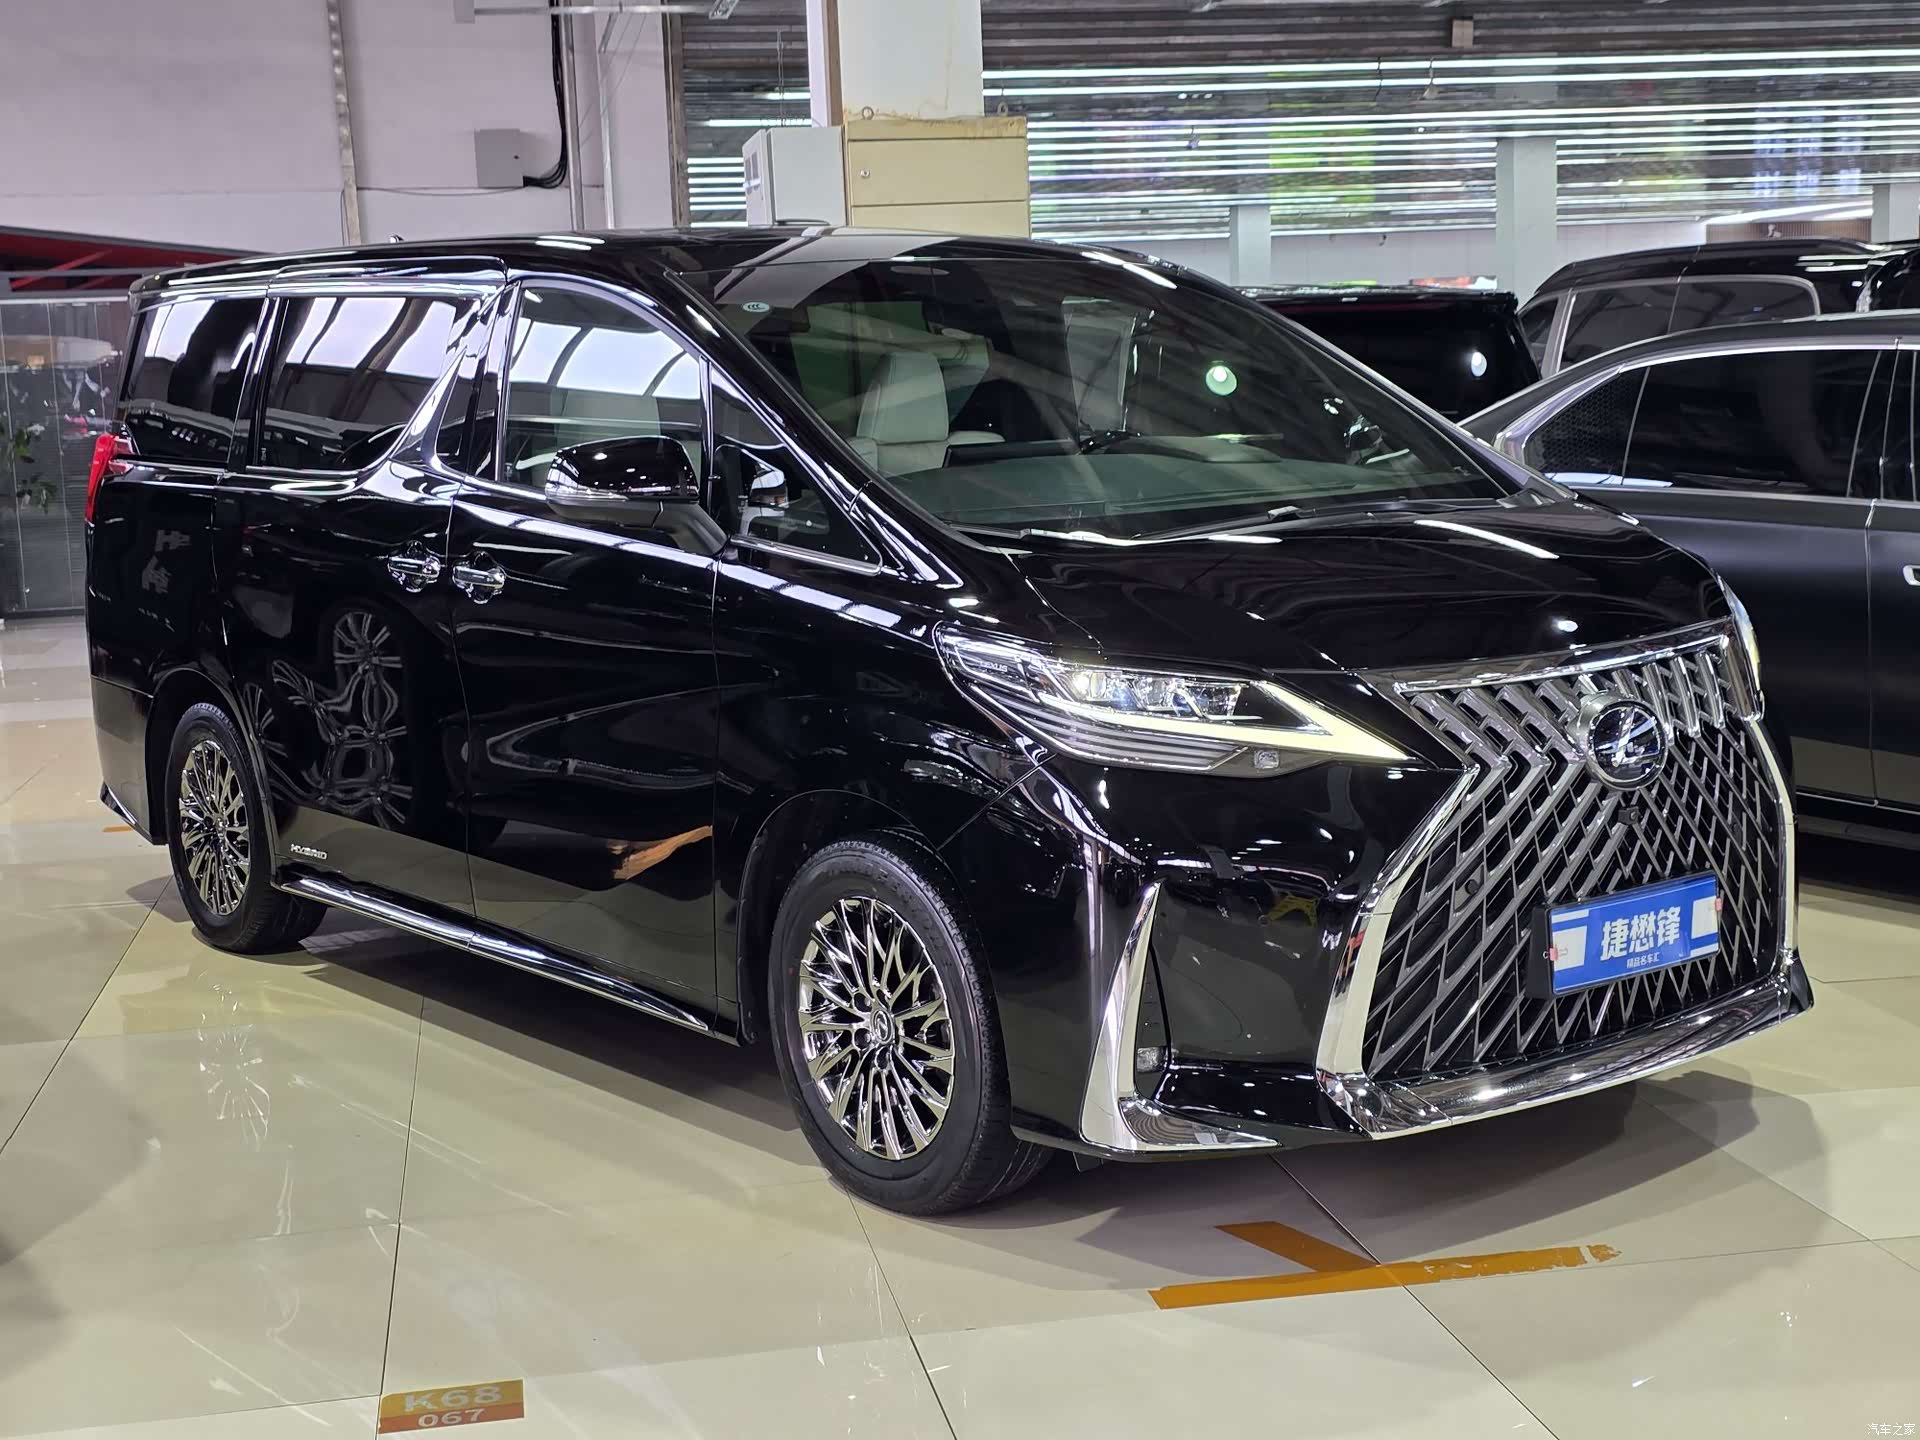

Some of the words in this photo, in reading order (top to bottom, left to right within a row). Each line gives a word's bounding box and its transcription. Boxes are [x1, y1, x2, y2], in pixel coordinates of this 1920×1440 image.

[1600, 906, 1680, 960] 捷懋锋
[404, 1386, 502, 1412] K68
[417, 1408, 485, 1428] 067
